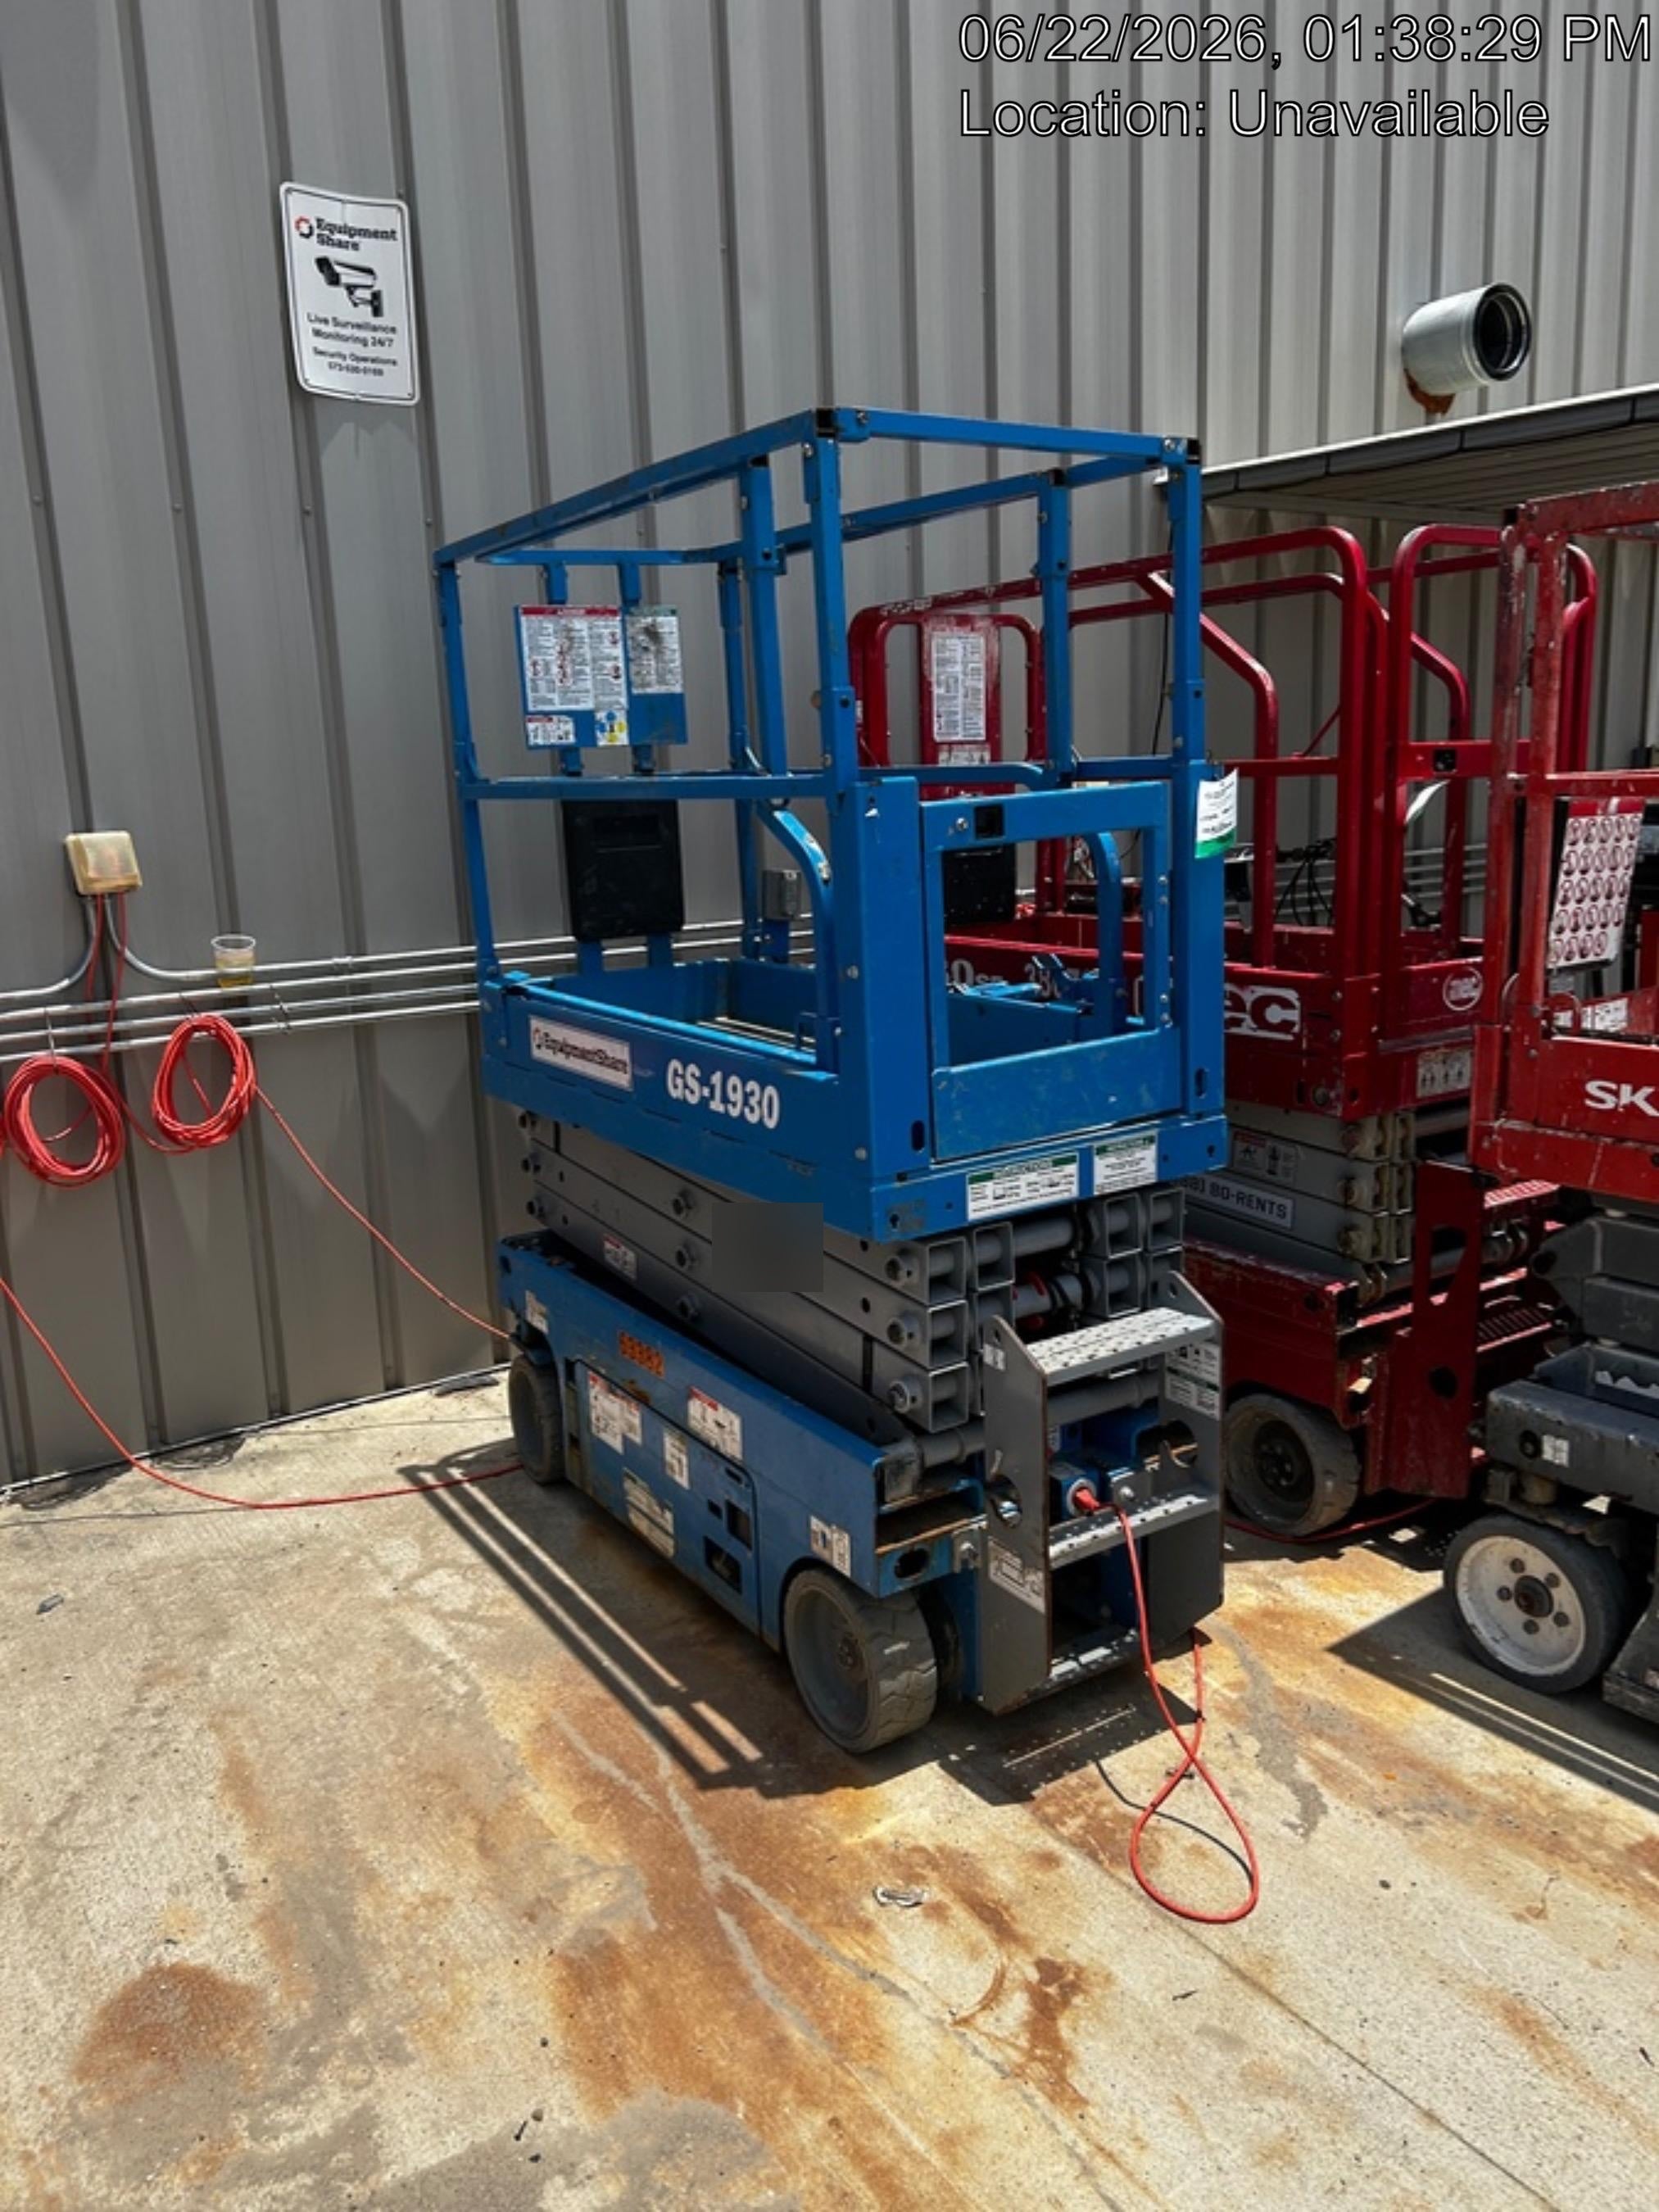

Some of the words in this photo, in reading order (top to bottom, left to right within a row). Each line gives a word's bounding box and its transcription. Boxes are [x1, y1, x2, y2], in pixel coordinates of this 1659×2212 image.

[315, 216, 398, 242] Equipment
[316, 233, 360, 252] Share
[307, 312, 329, 326] Live
[331, 316, 397, 335] Surveillance
[312, 328, 369, 347] Monitoring
[370, 336, 394, 348] 24/7
[665, 1058, 780, 1130] GS-1930
[1208, 1181, 1287, 1220] 80-RENTS
